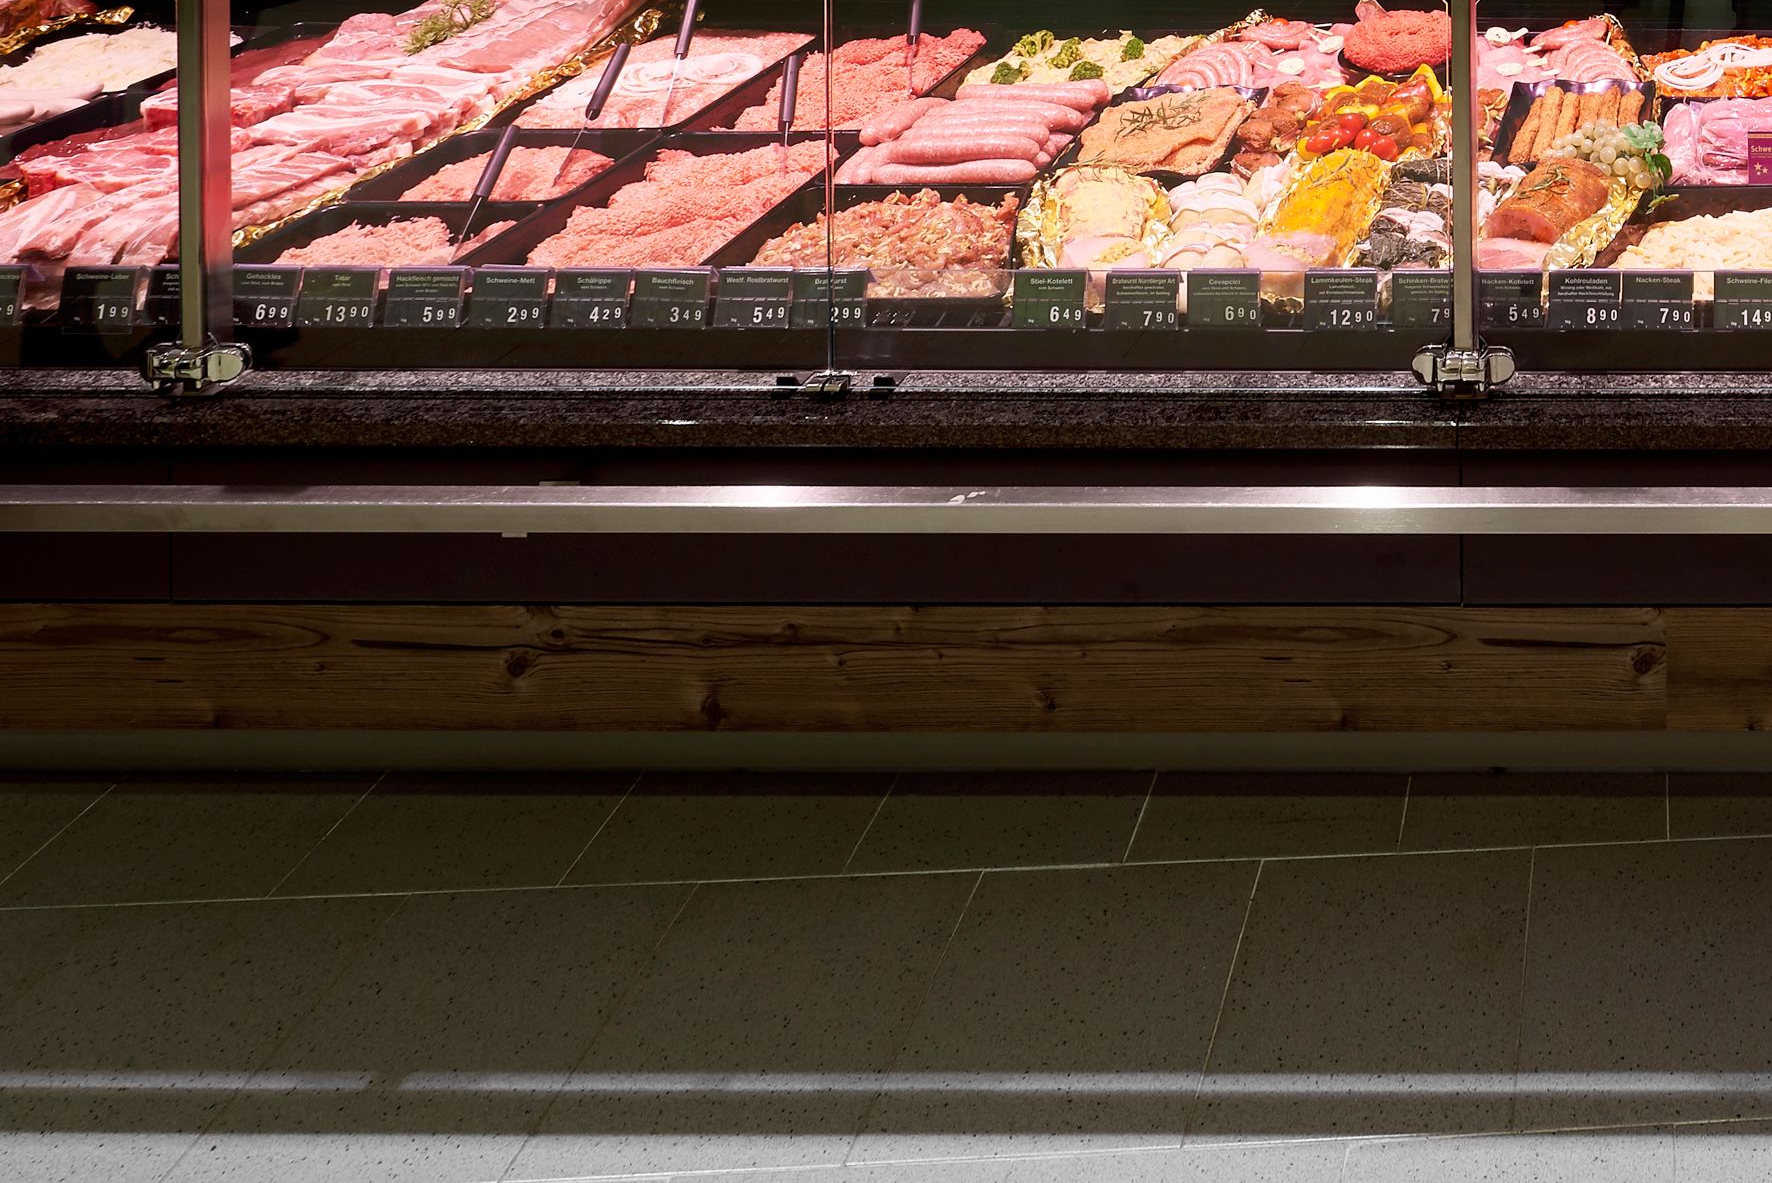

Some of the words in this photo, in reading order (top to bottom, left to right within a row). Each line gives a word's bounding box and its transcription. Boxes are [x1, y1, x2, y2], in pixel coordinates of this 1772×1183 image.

[652, 277, 694, 285] Bauchfleisch
[1565, 277, 1608, 285] Kohlrouladen
[1636, 276, 1681, 284] Nacken-Steak
